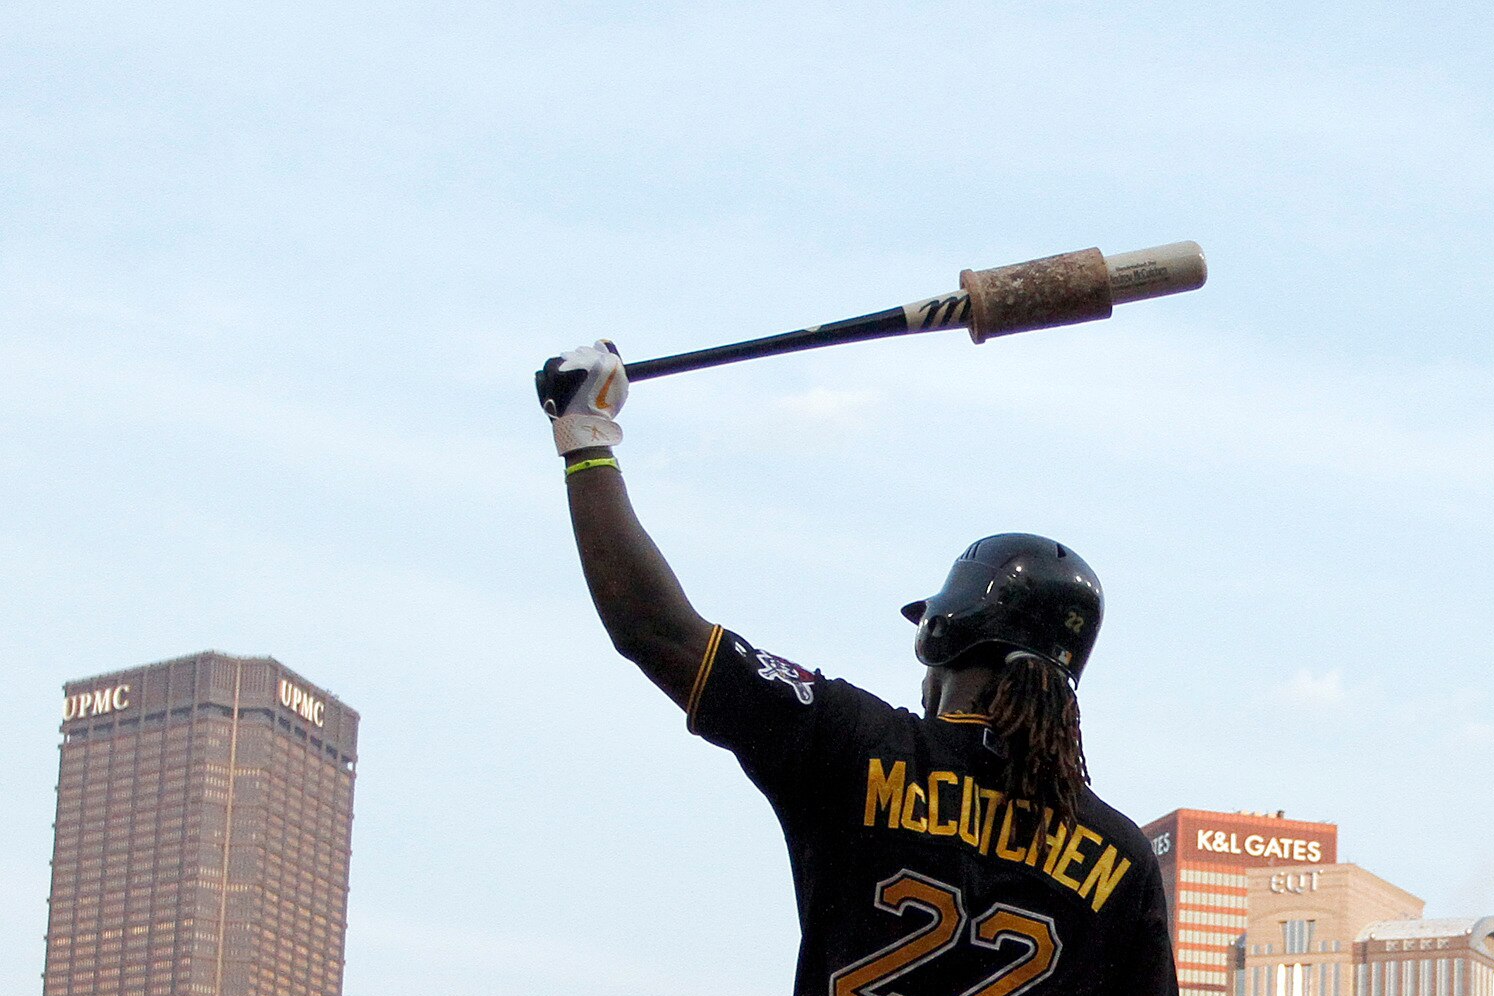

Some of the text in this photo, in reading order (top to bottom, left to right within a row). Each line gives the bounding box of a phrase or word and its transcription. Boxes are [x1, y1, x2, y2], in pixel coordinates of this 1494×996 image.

[62, 684, 131, 722] UPMC
[280, 679, 325, 728] UPMC
[1196, 829, 1322, 863] K&L GATES
